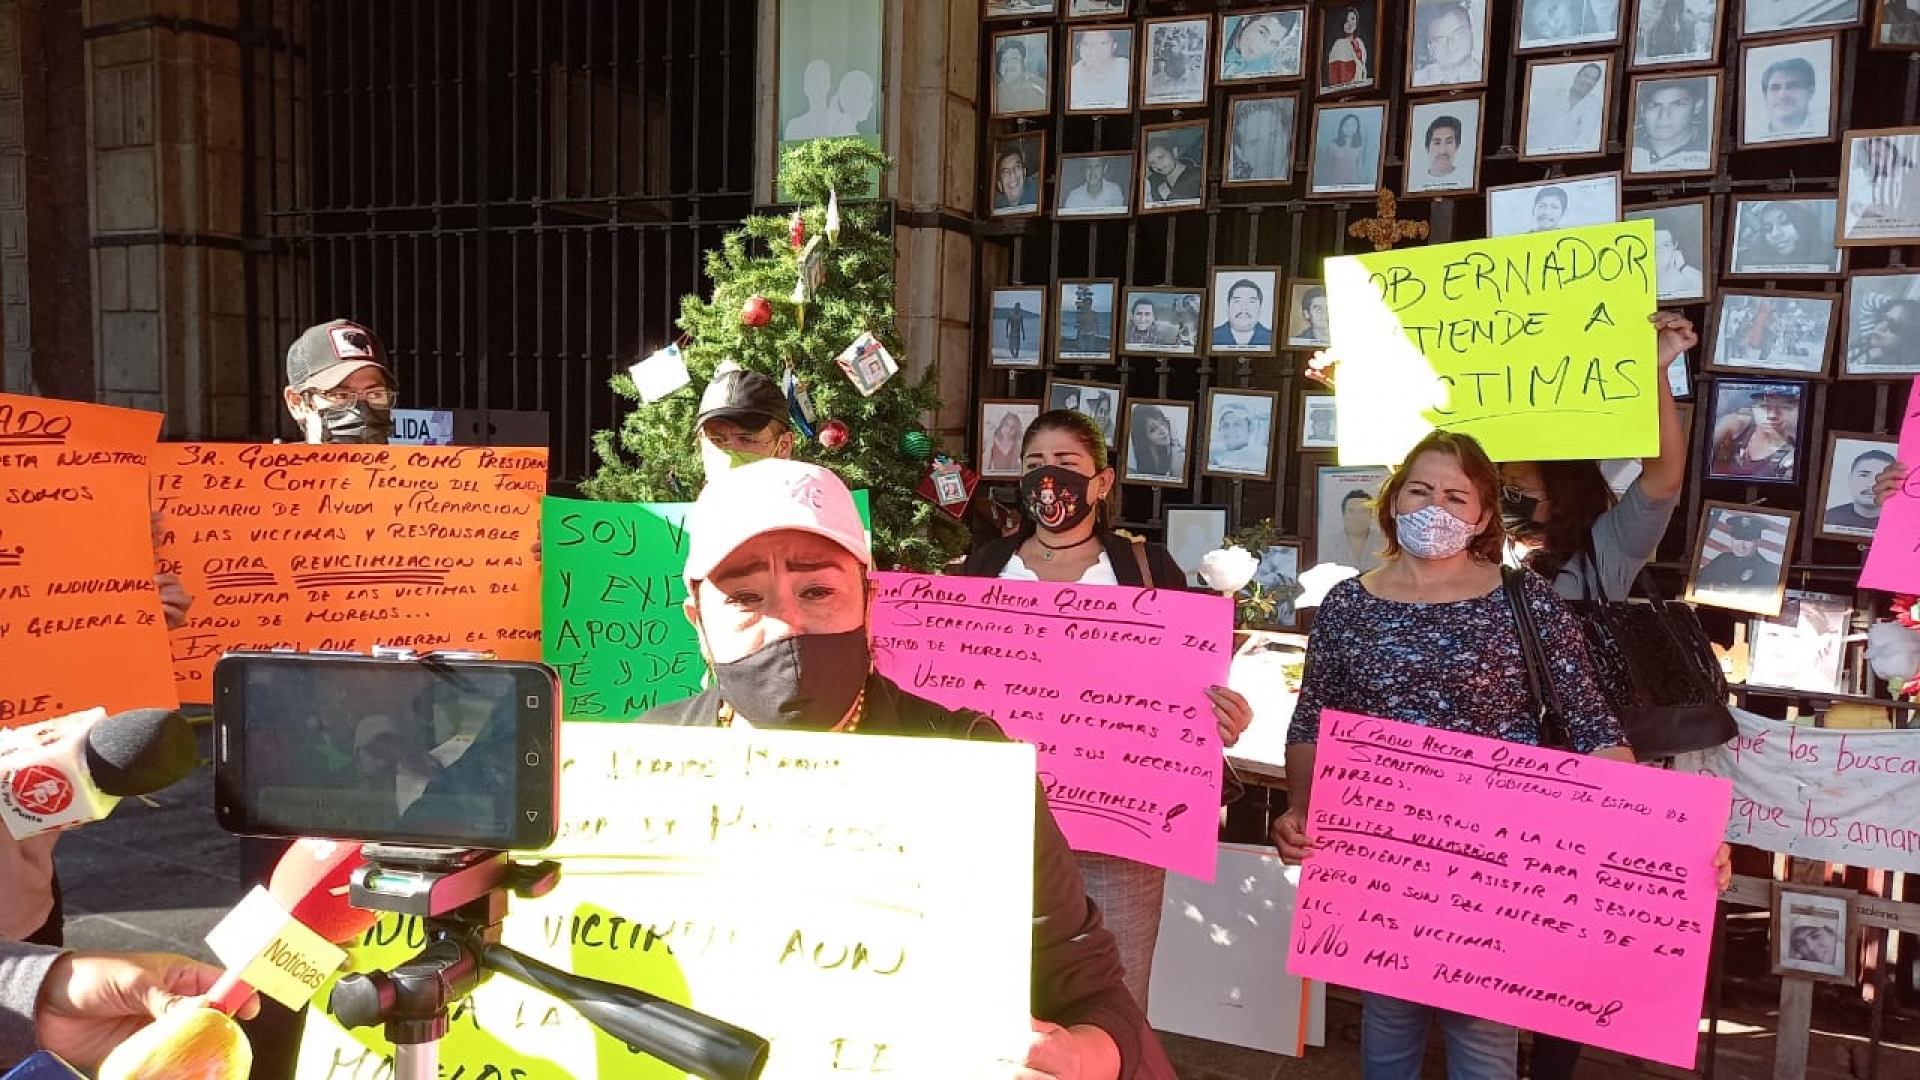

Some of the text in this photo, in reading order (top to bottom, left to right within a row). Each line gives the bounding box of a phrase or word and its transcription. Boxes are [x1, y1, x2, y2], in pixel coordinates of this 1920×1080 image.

[1402, 302, 1615, 355] TIENDE A
[6, 486, 94, 503] SOMOS
[156, 474, 184, 492] TE
[203, 473, 247, 490] DEL
[264, 469, 352, 491] COMITE
[363, 467, 439, 490] TECNICO
[450, 479, 480, 493] DEL
[272, 502, 301, 517] DE
[318, 494, 373, 515] AYUDA
[162, 530, 176, 547] A
[192, 529, 232, 544] LAS
[250, 527, 347, 543] VICTIMAS
[386, 523, 520, 541] RESPONSABLE
[556, 513, 637, 556] SOY
[157, 554, 523, 575] DE OTRA REVICTIMIZACION MAS
[213, 582, 520, 607] CONTRA DE LAS VICTIMAS DEL
[558, 568, 572, 610] Y
[26, 615, 127, 638] GENERAL
[136, 609, 157, 626] DE
[258, 615, 283, 627] DE
[555, 618, 669, 652] APOYO
[466, 631, 489, 643] EL
[927, 639, 947, 652] DE
[1023, 623, 1049, 638] DE
[1064, 623, 1162, 646] GOBIERNO
[1181, 634, 1219, 653] DEL
[612, 660, 633, 687] Y
[643, 651, 697, 684] DE
[913, 659, 966, 689] USTED
[973, 679, 987, 691] A
[1079, 689, 1198, 720] CONTACTO
[1073, 746, 1106, 760] SUS
[1788, 726, 1819, 764] los
[1340, 785, 1397, 813] USTED
[1494, 827, 1509, 839] A
[1520, 830, 1542, 844] LA
[1555, 838, 1587, 855] LIC
[1606, 851, 1689, 878] LUCERO
[1805, 798, 1838, 839] los
[1314, 836, 1431, 872] EXPEDIENTES
[1562, 892, 1579, 907] A
[1593, 897, 1702, 935] SESIONES
[1523, 857, 1578, 880] PARA
[1595, 870, 1688, 902] REVISAR
[1307, 863, 1358, 886] PERO
[1367, 879, 1392, 893] NO
[1602, 929, 1637, 948] DE
[1358, 908, 1400, 931] LAS
[263, 938, 325, 990] Noticias
[1363, 949, 1410, 971] MAS
